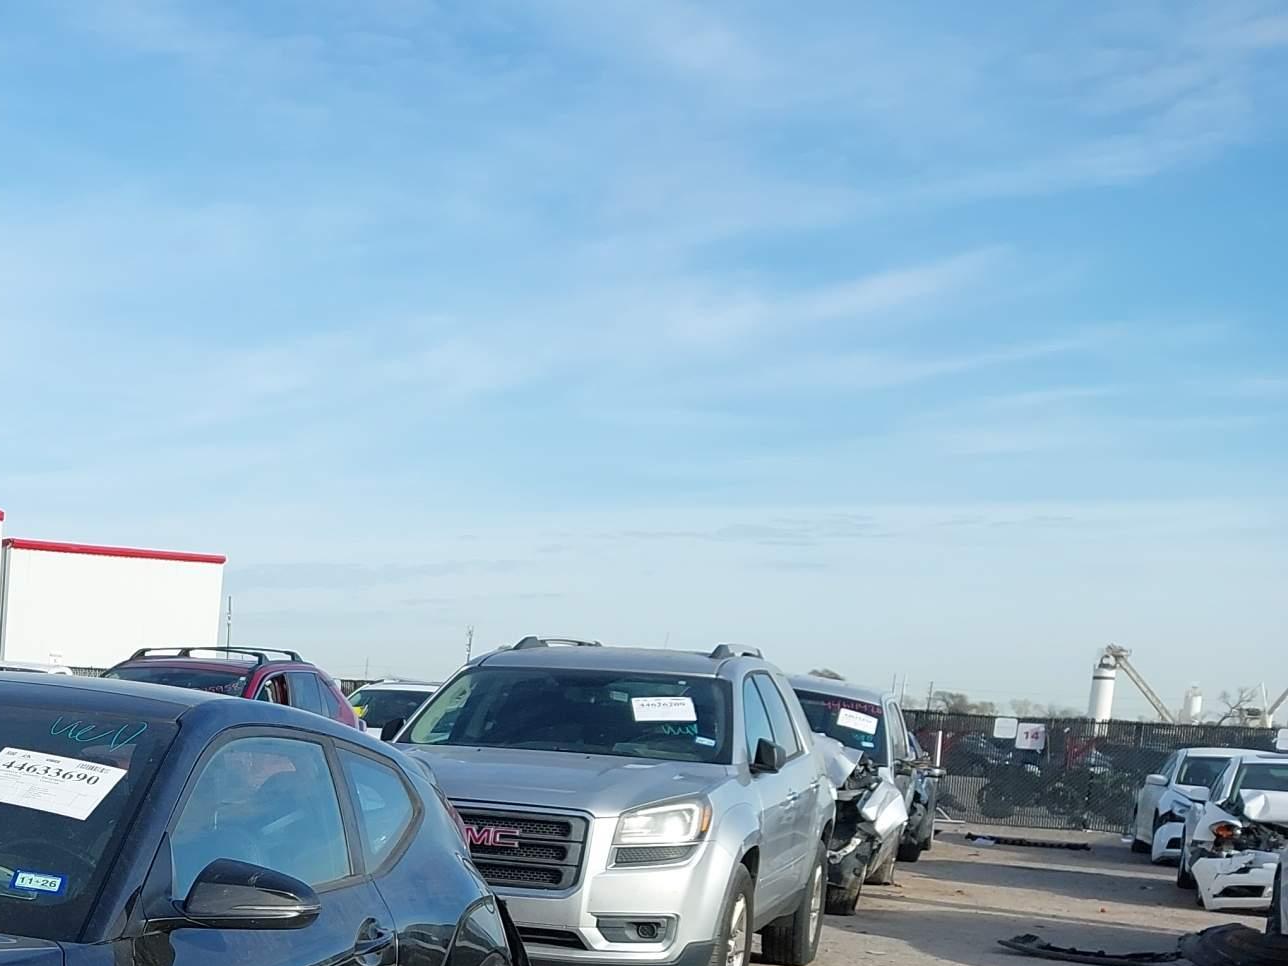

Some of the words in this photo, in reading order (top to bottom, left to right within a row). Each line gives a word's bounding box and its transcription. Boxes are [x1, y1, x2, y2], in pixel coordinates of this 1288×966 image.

[1023, 731, 1039, 740] 14
[2, 760, 100, 786] 44633690
[463, 825, 520, 848] MC
[19, 876, 57, 888] 11-26
